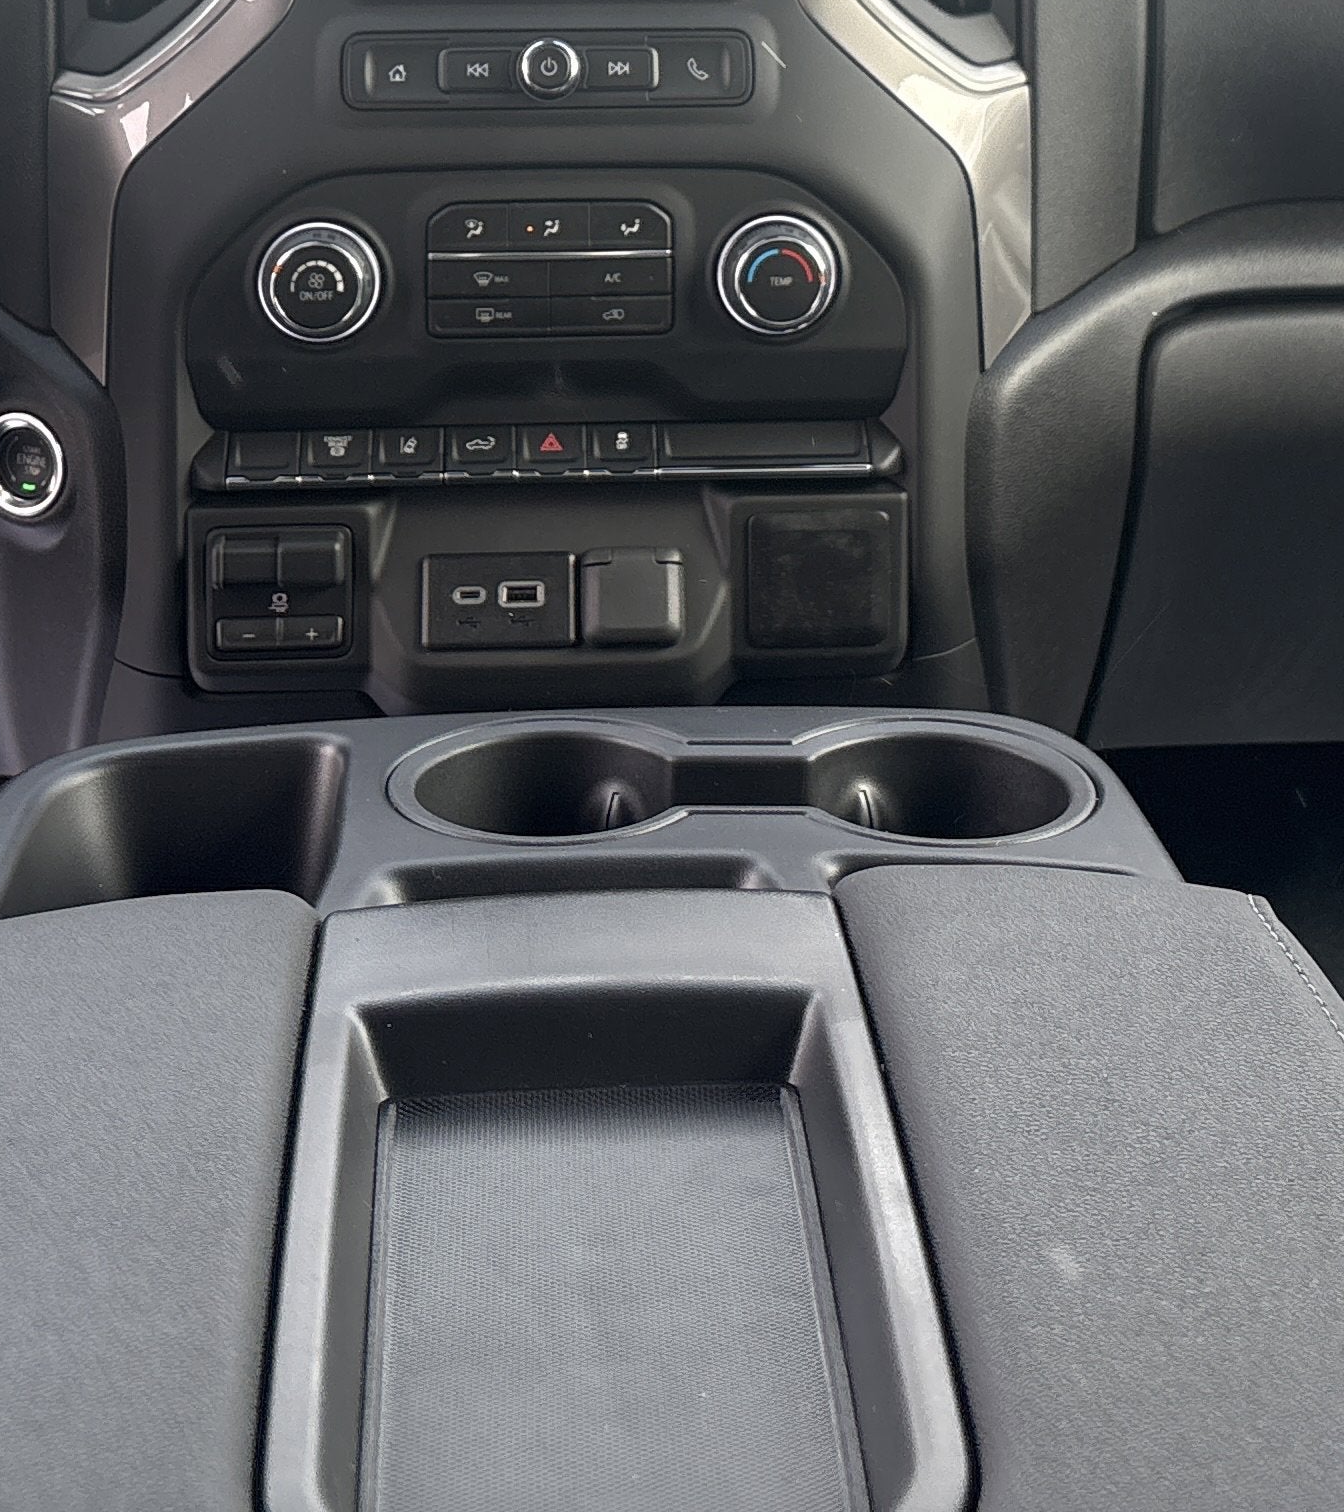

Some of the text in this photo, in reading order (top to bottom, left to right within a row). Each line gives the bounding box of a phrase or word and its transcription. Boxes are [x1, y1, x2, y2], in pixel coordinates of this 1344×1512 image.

[604, 273, 622, 284] A/C
[769, 276, 794, 287] TEMP
[299, 290, 334, 301] ON/OFF
[495, 311, 513, 320] REAR
